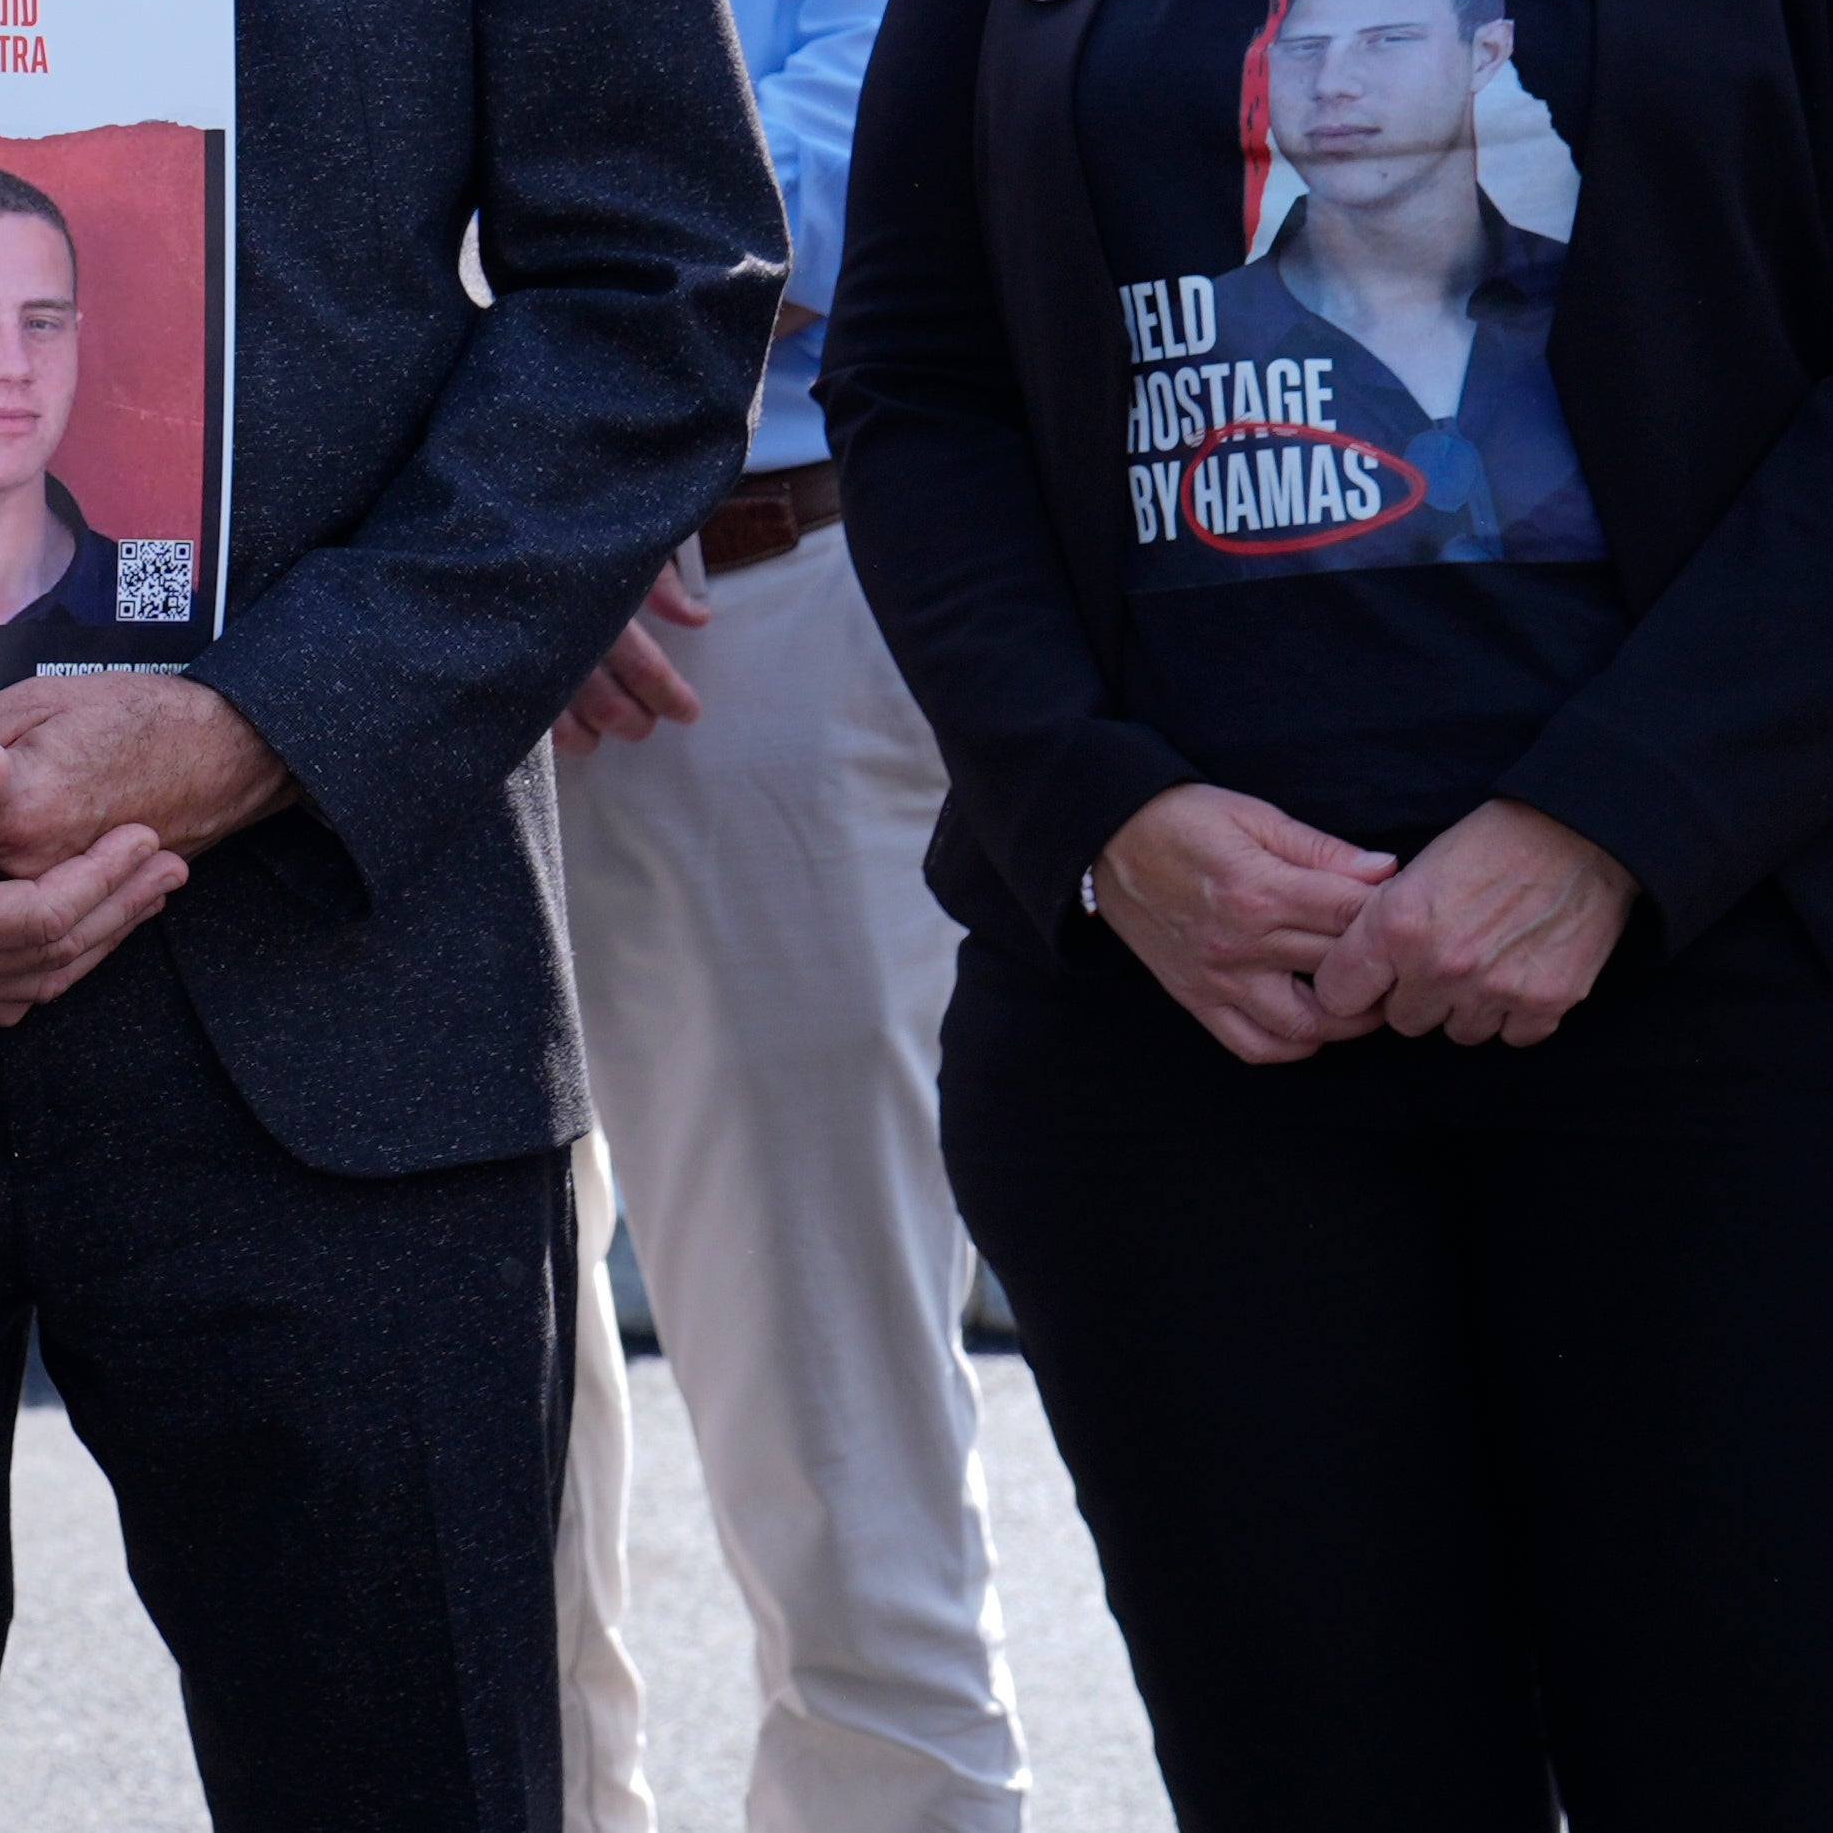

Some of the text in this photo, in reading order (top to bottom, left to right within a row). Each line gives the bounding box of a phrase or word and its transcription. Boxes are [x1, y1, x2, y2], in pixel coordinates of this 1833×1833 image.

[1127, 358, 1337, 454] HOSTAGE
[1128, 445, 1382, 544] BY HAMAS
